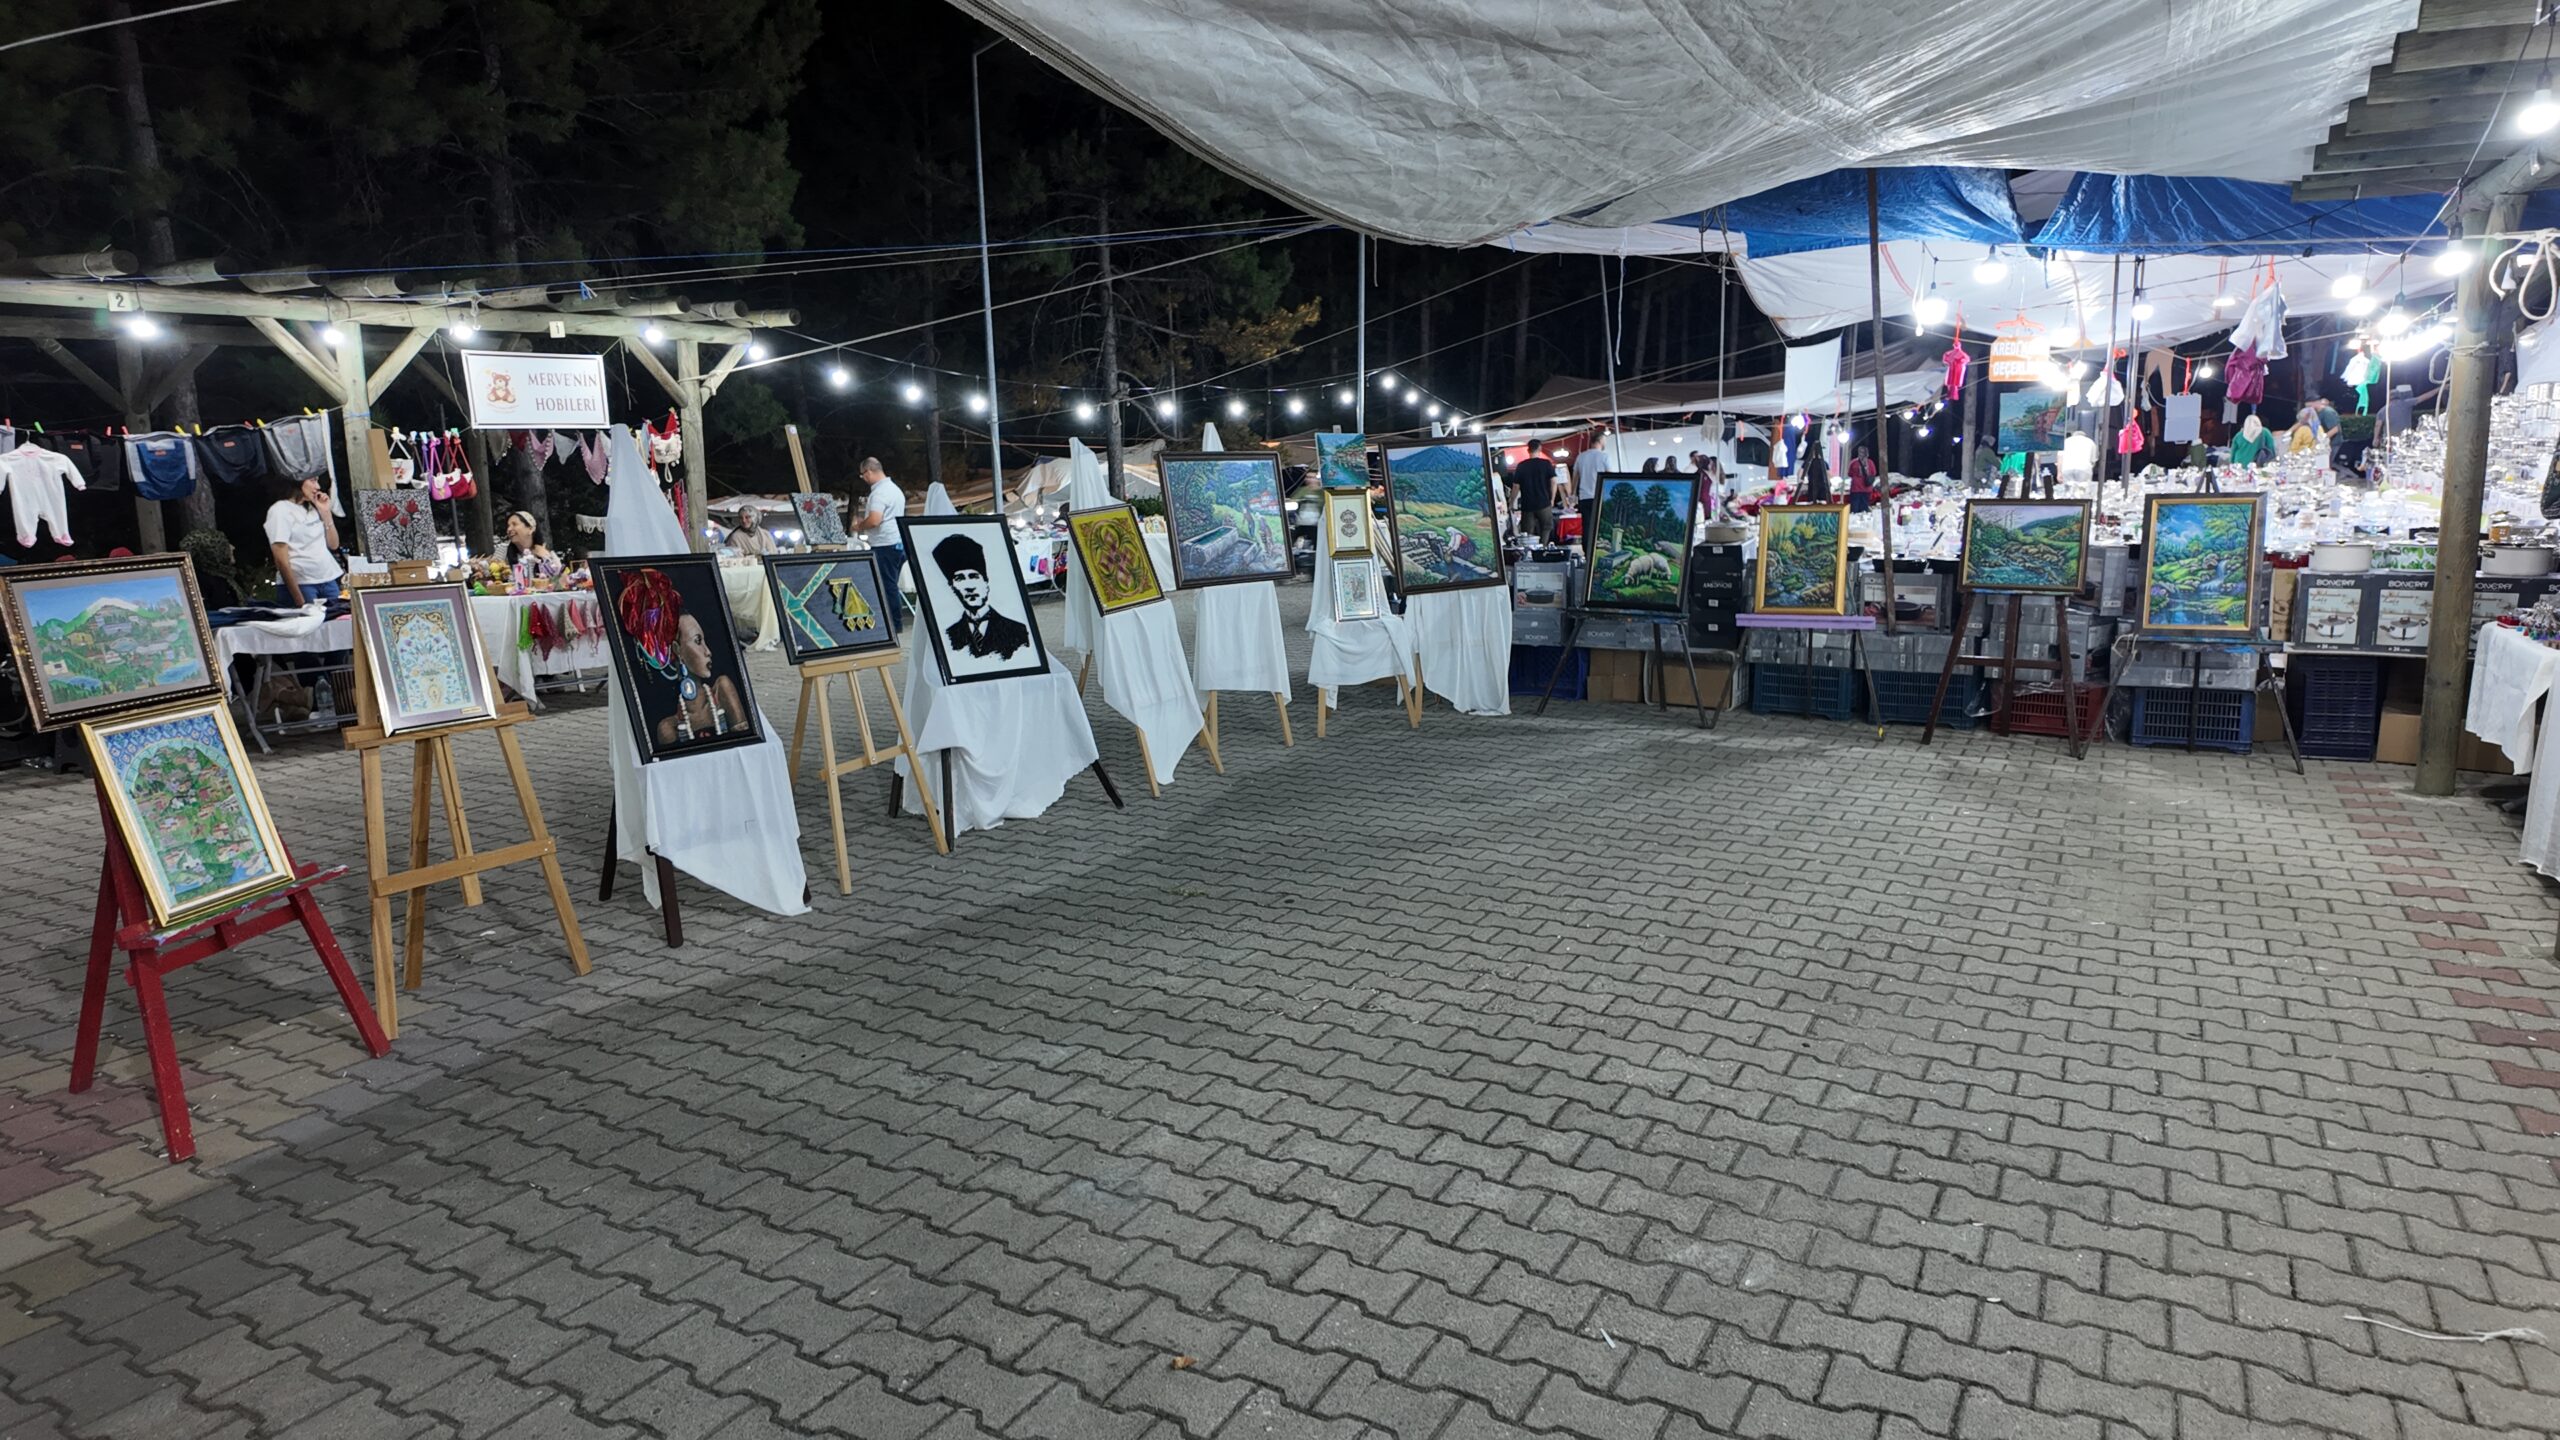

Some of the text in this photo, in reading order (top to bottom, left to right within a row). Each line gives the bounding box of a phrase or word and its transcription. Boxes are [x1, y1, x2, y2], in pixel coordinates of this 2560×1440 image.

[115, 293, 126, 308] 2
[527, 370, 599, 388] MERVE'NİN
[535, 395, 597, 412] HOBİLERİ
